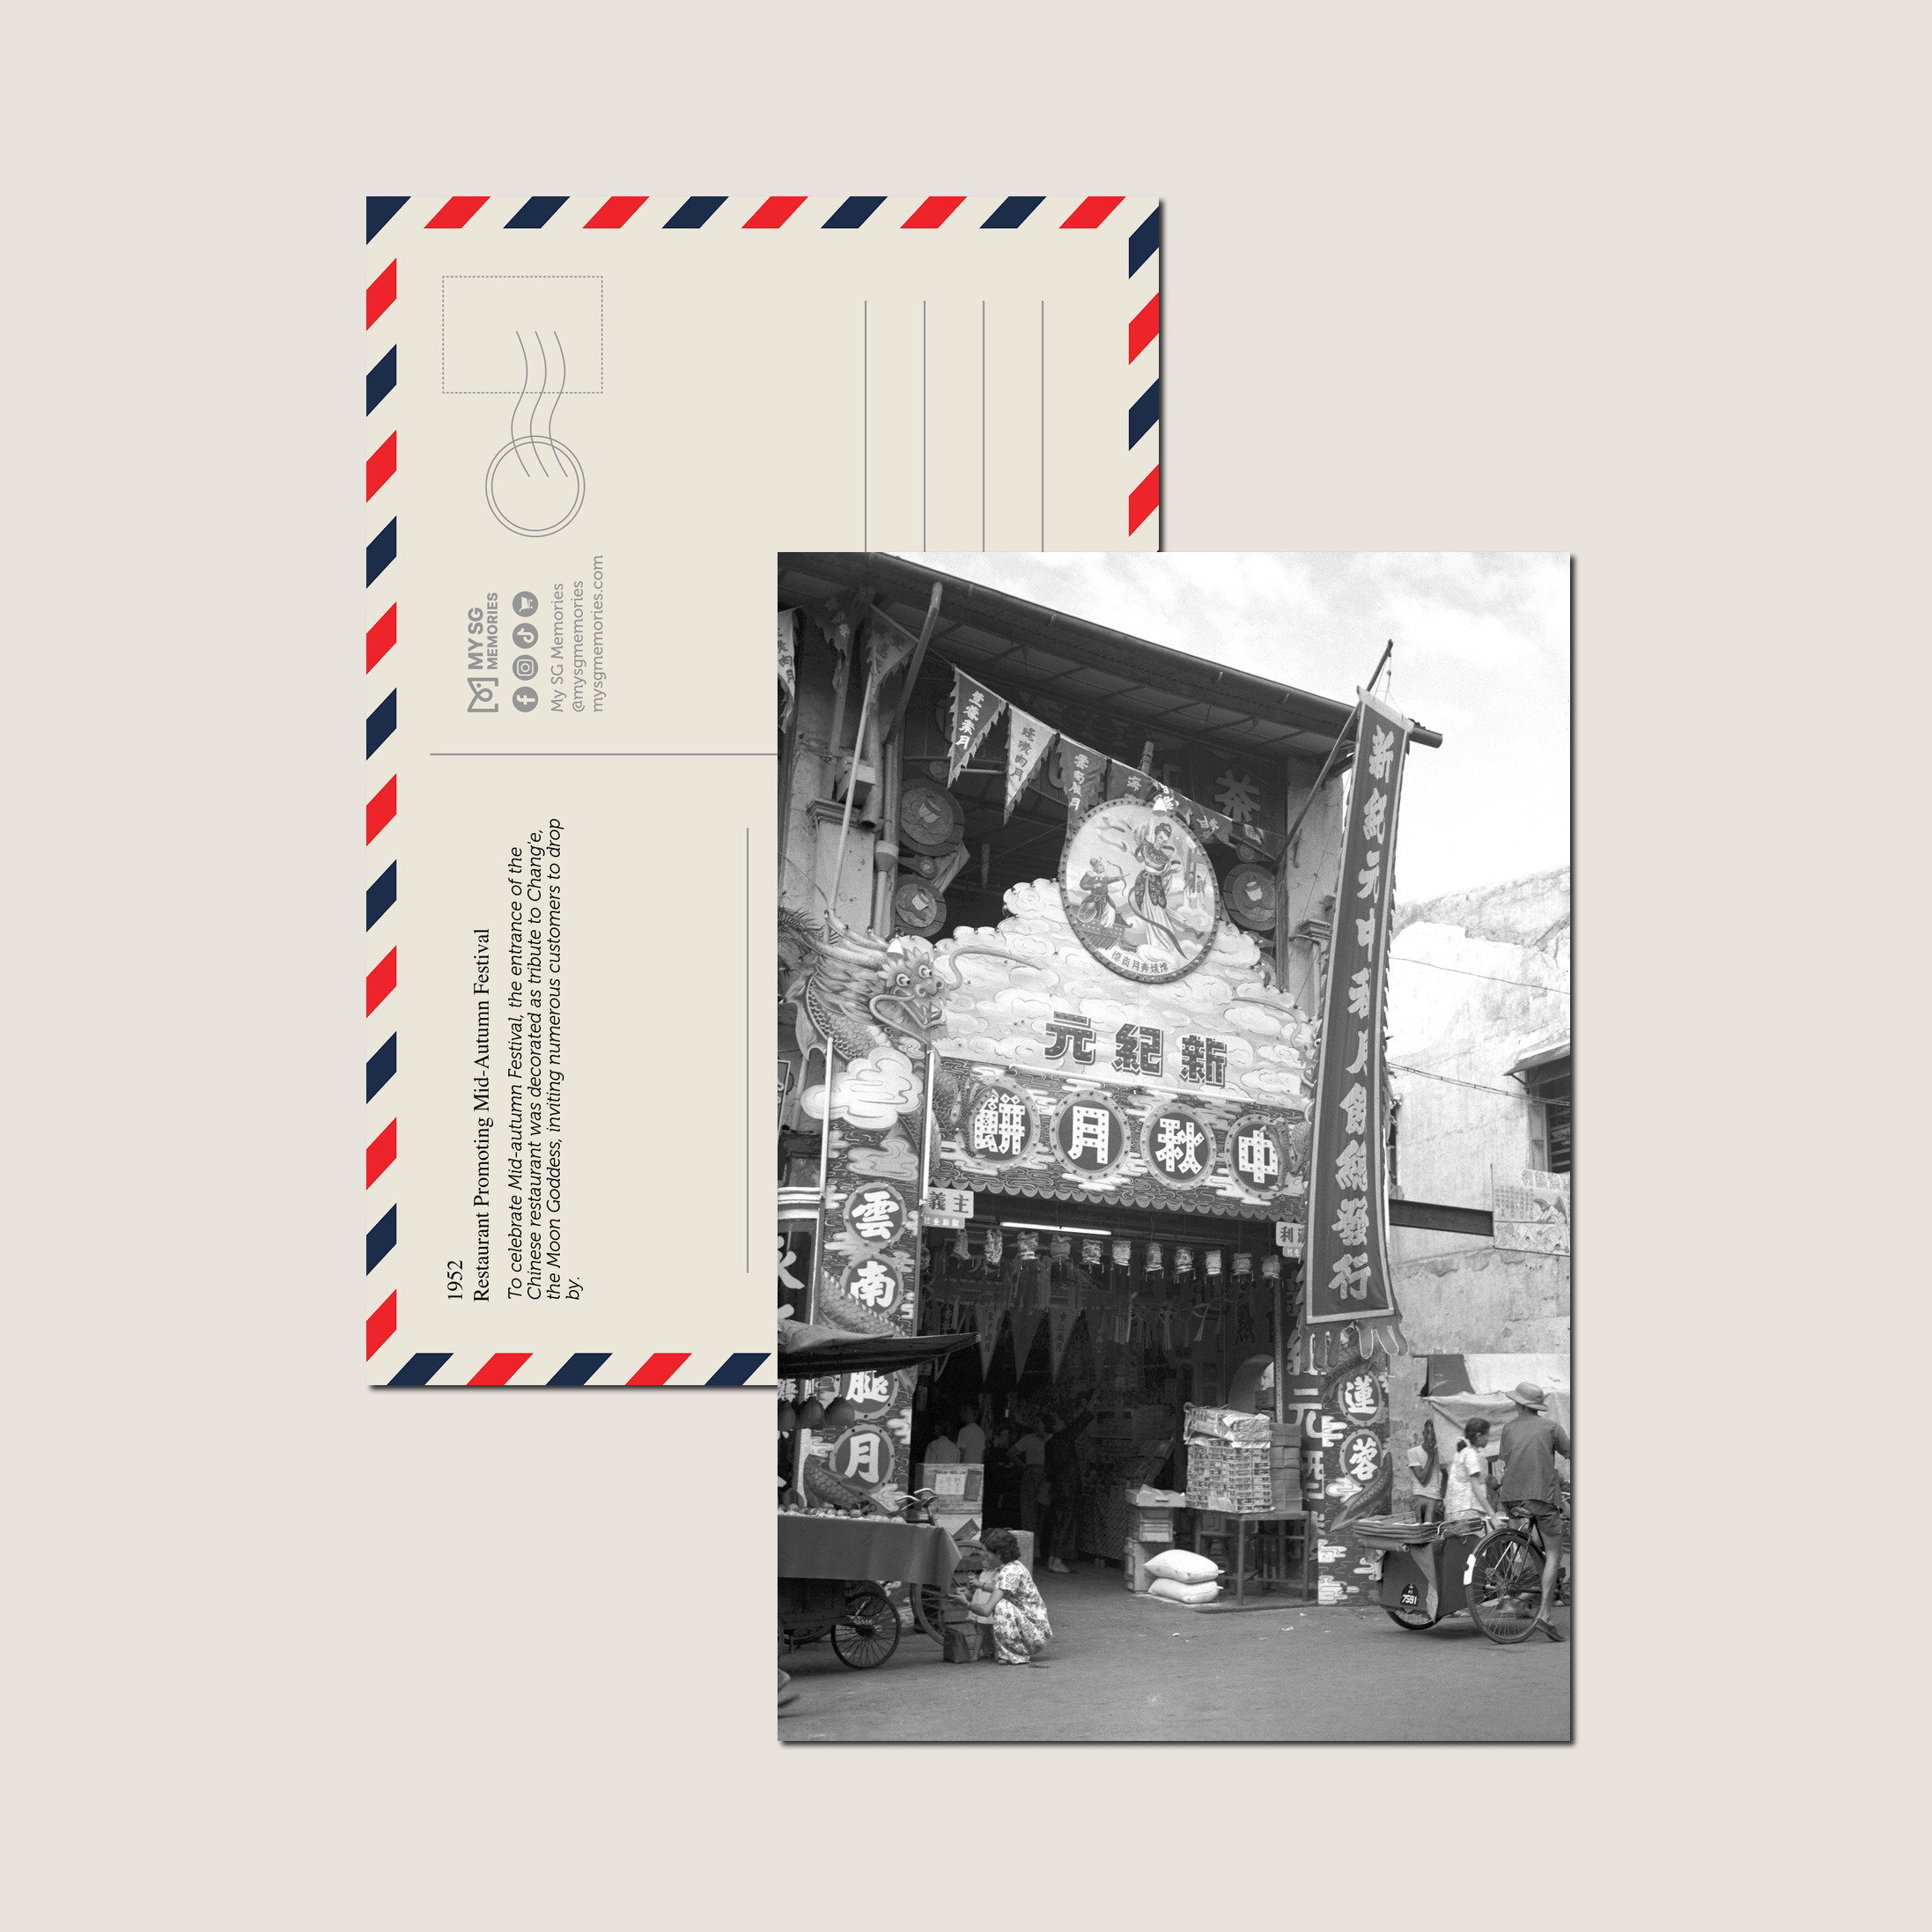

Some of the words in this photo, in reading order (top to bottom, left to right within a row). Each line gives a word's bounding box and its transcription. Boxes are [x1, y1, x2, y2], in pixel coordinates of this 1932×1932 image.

[468, 608, 483, 634] SG
[487, 593, 498, 669] MEMORIES
[551, 583, 564, 660] Memories
[571, 580, 586, 712] @mysgmemories
[591, 555, 606, 712] mysgmemories.com
[468, 638, 483, 669] MY
[550, 665, 564, 684] SG
[551, 689, 567, 712] My
[508, 847, 522, 874] the
[527, 830, 545, 901] Chang'e,
[546, 819, 564, 858] drop
[508, 877, 522, 896] of
[547, 863, 560, 879] to
[509, 902, 522, 976] entrance
[527, 908, 541, 924] to
[547, 885, 560, 973] customers
[474, 929, 489, 995] Festival
[527, 930, 541, 984] tribute
[508, 981, 522, 1007] the
[530, 990, 541, 1007] as
[549, 978, 560, 1065] numerous
[474, 1000, 489, 1111] Mid-Autumn
[508, 1015, 524, 1078] Festival,
[527, 1013, 541, 1097] decorated
[530, 1102, 541, 1136] was
[546, 1069, 564, 1132] inviting
[474, 1117, 493, 1206] Promoting
[508, 1085, 522, 1191] Mid-autumn
[527, 1141, 541, 1227] restaurant
[546, 1139, 562, 1213] Goddess,
[474, 1213, 489, 1302] Restaurant
[508, 1195, 522, 1272] celebrate
[546, 1219, 560, 1268] Moon
[446, 1260, 463, 1300] 1952
[508, 1278, 522, 1299] To
[527, 1232, 541, 1300] Chinese
[546, 1273, 560, 1299] the
[565, 1278, 583, 1300] by.
[1402, 1594, 1418, 1604] 7591
